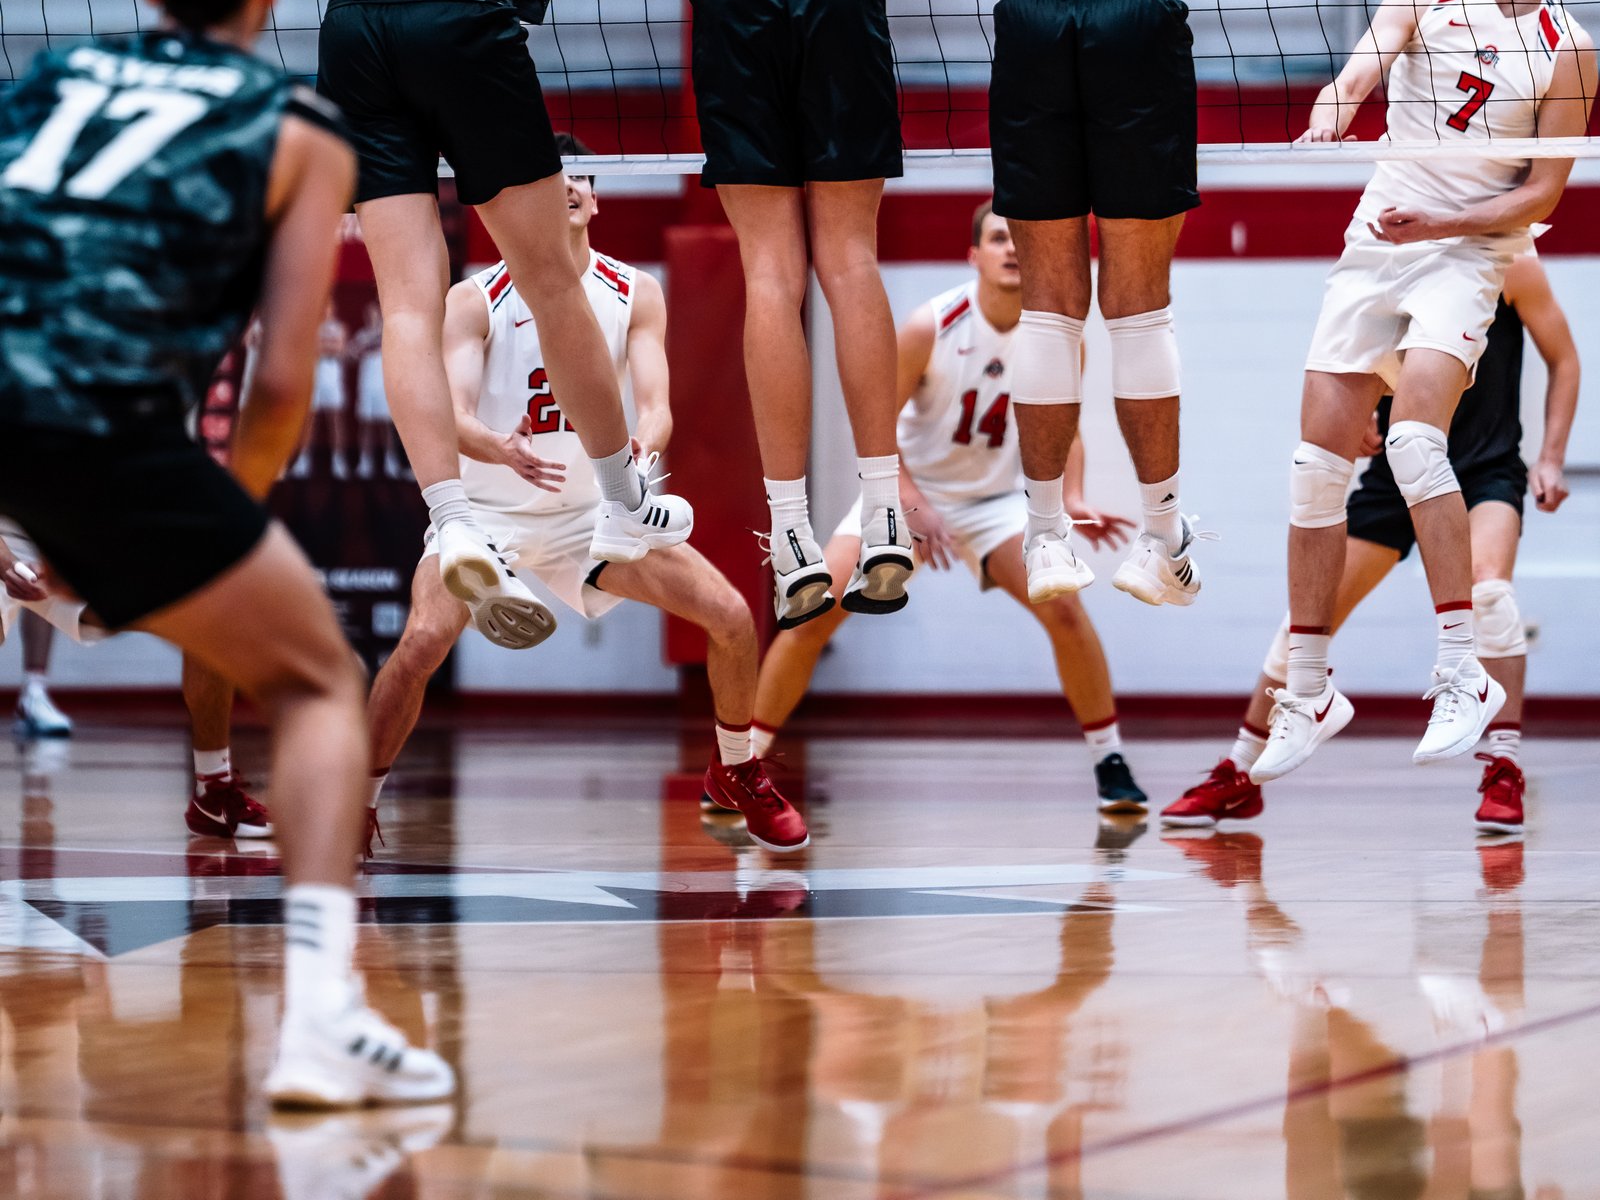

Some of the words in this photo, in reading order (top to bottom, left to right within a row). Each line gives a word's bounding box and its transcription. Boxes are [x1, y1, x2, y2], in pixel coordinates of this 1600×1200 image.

[1446, 70, 1495, 133] 7
[2, 77, 210, 199] 17
[527, 367, 578, 435] 2
[952, 388, 1010, 450] 14
